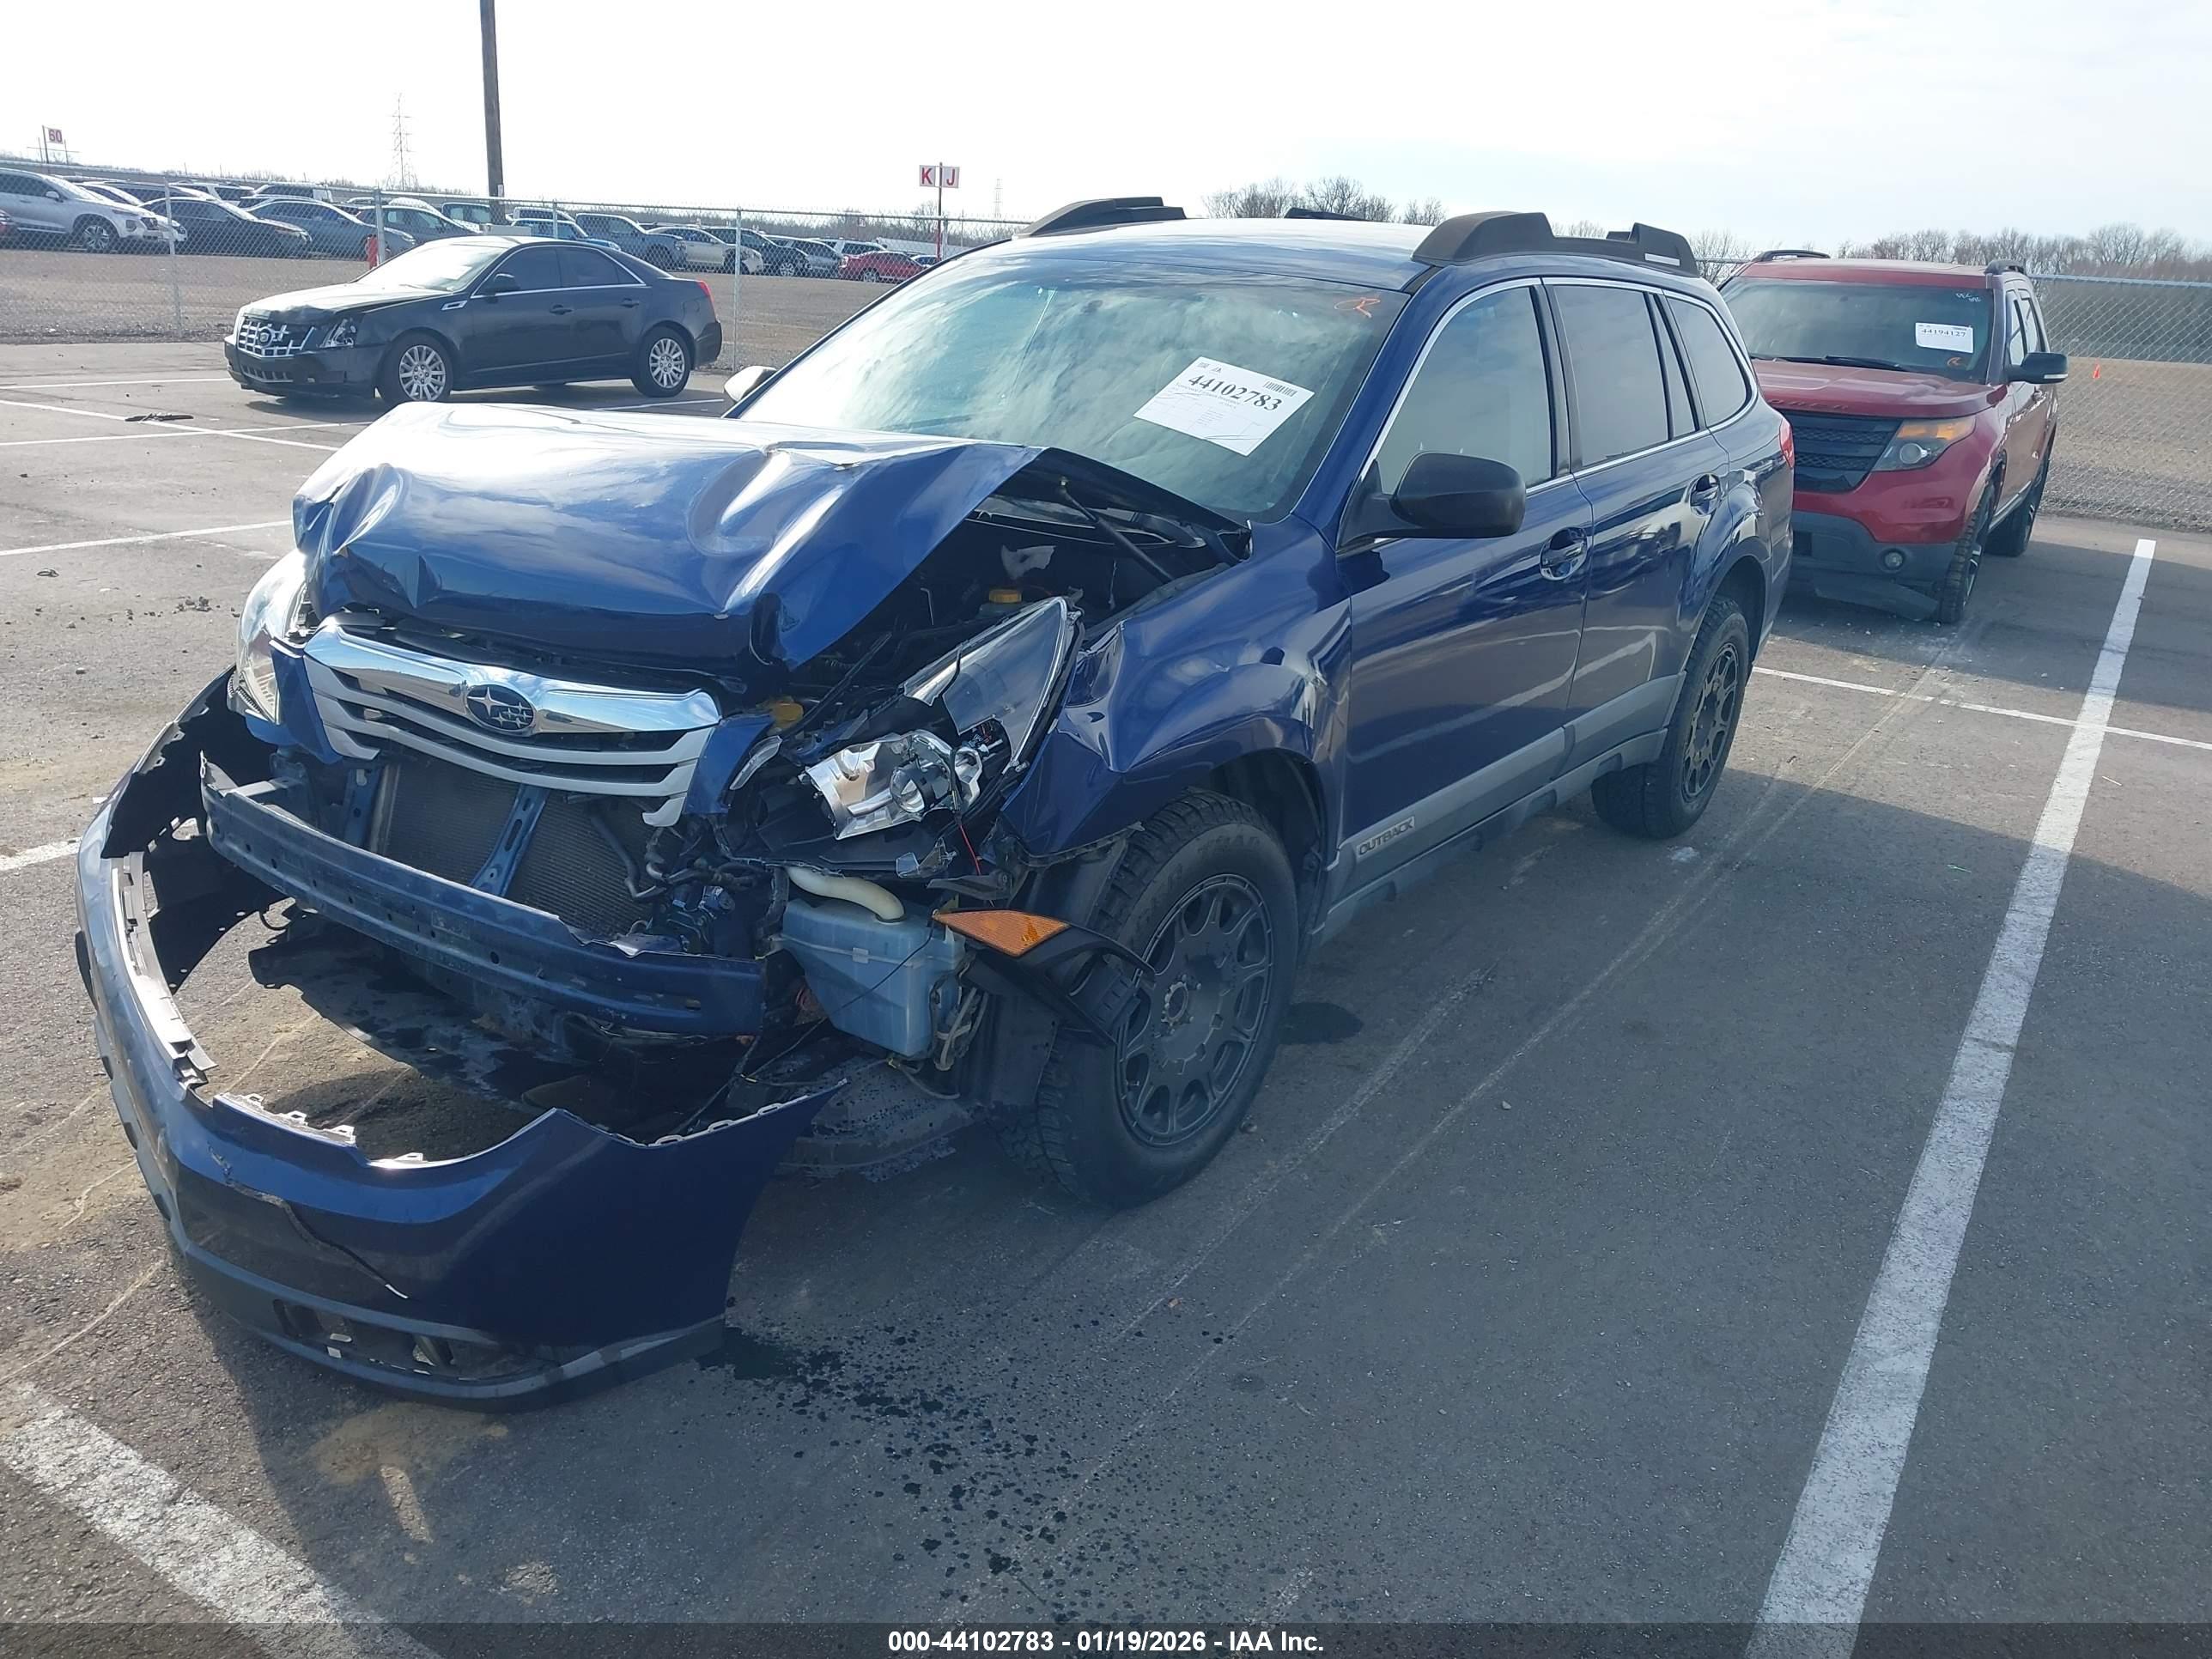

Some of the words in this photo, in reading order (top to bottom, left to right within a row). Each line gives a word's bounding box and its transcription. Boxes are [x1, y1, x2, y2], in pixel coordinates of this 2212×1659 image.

[48, 129, 63, 143] 60
[921, 167, 933, 185] K
[945, 167, 956, 186] J
[1921, 328, 1966, 337] 44194127
[1188, 374, 1283, 411] 44102783
[1359, 817, 1413, 855] OUTBACK
